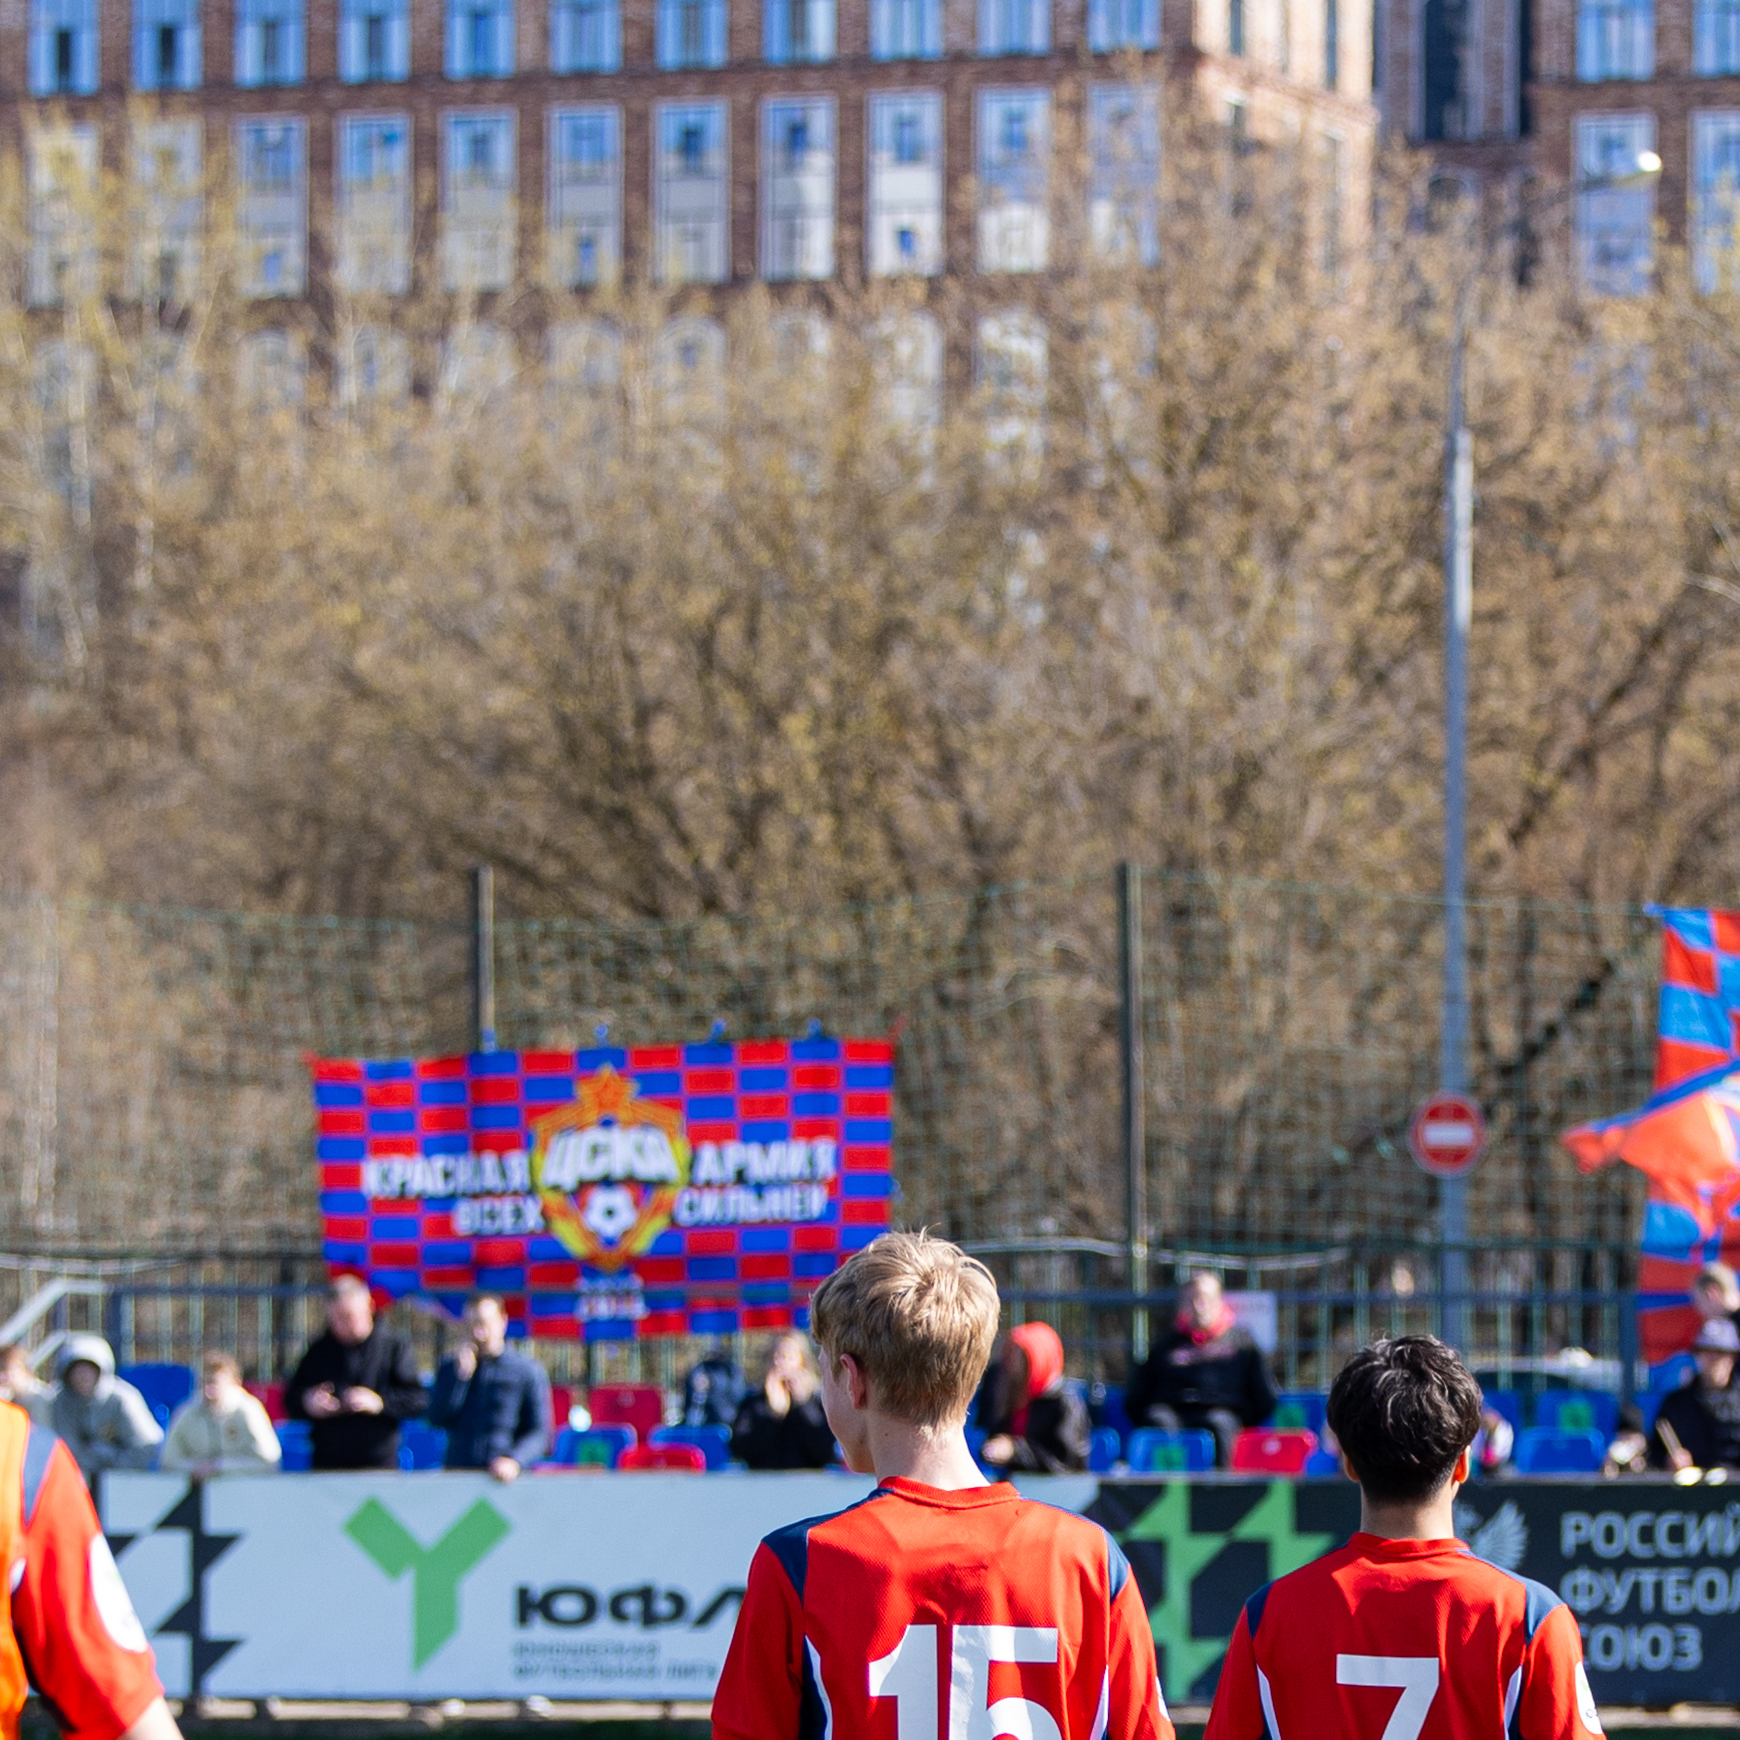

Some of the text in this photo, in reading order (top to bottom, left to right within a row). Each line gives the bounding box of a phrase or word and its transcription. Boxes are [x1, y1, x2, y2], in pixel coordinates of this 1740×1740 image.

[362, 1139, 836, 1198] КРАСНАЯ АРМИЯ
[542, 1126, 679, 1192] ЦСКА
[1579, 1622, 1703, 1671] ОЮЗ
